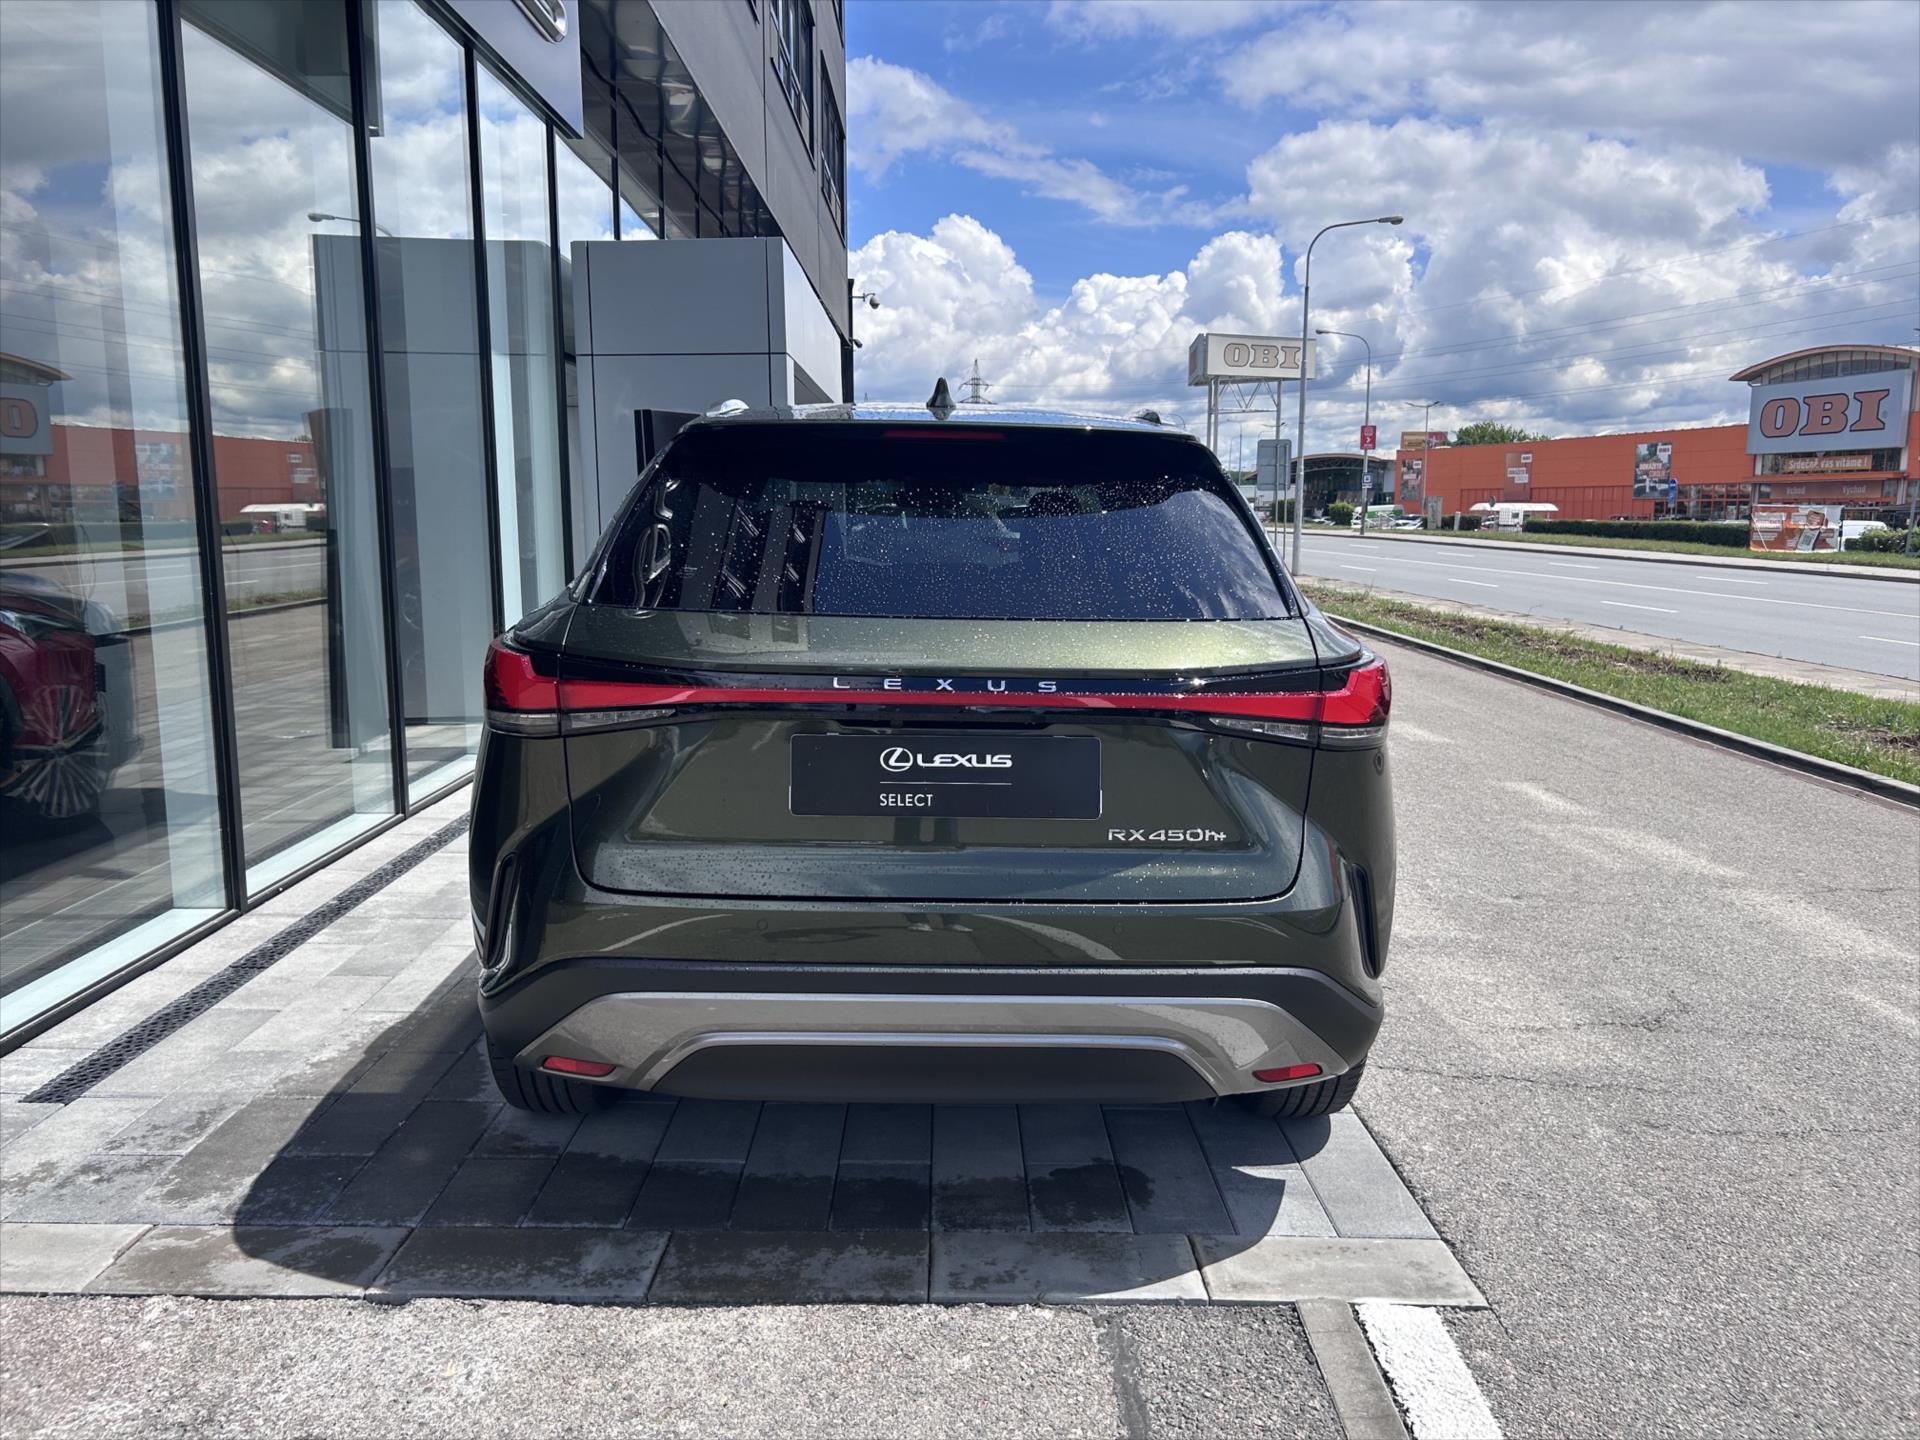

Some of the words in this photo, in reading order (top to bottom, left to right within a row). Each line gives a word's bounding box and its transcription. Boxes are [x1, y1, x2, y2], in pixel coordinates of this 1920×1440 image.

[1223, 343, 1302, 369] OBI
[1760, 389, 1890, 438] OBI
[833, 677, 1057, 693] LEXUS
[917, 753, 1013, 768] LEXUS
[879, 794, 933, 807] SELECT
